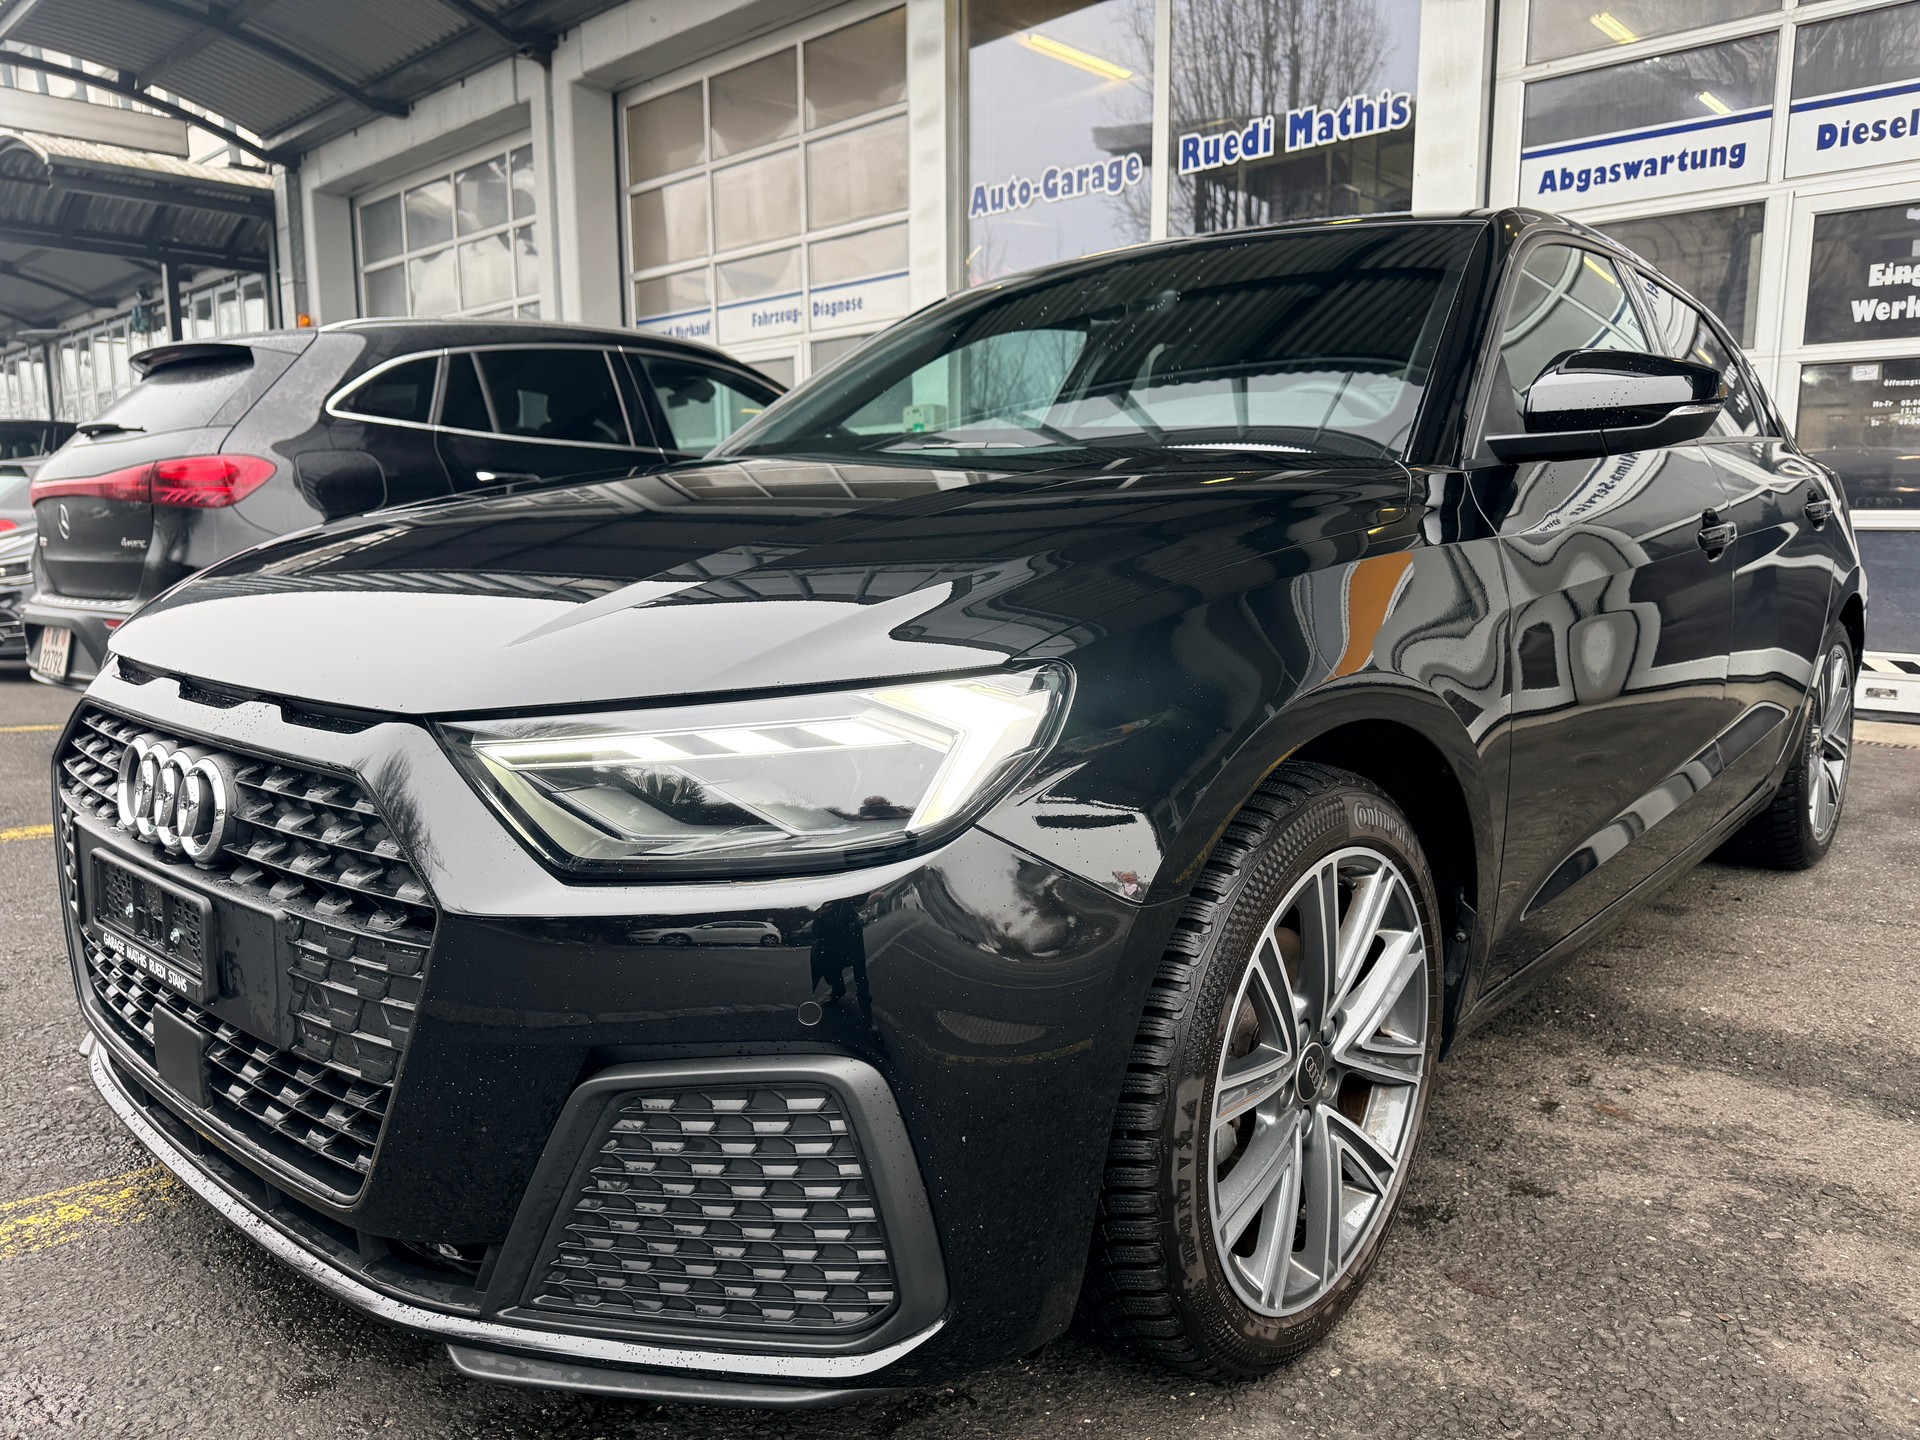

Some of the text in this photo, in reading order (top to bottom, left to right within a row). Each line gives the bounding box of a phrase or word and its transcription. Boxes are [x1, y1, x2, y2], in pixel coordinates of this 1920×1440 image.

[969, 90, 1411, 217] Auto-Garage Ruedi Mathis
[1816, 108, 1920, 151] Diesel
[1538, 142, 1747, 195] Abgaswartung
[812, 296, 863, 317] Diagnose
[103, 932, 188, 993] GARAGE MATHIS RUEDI STANS
